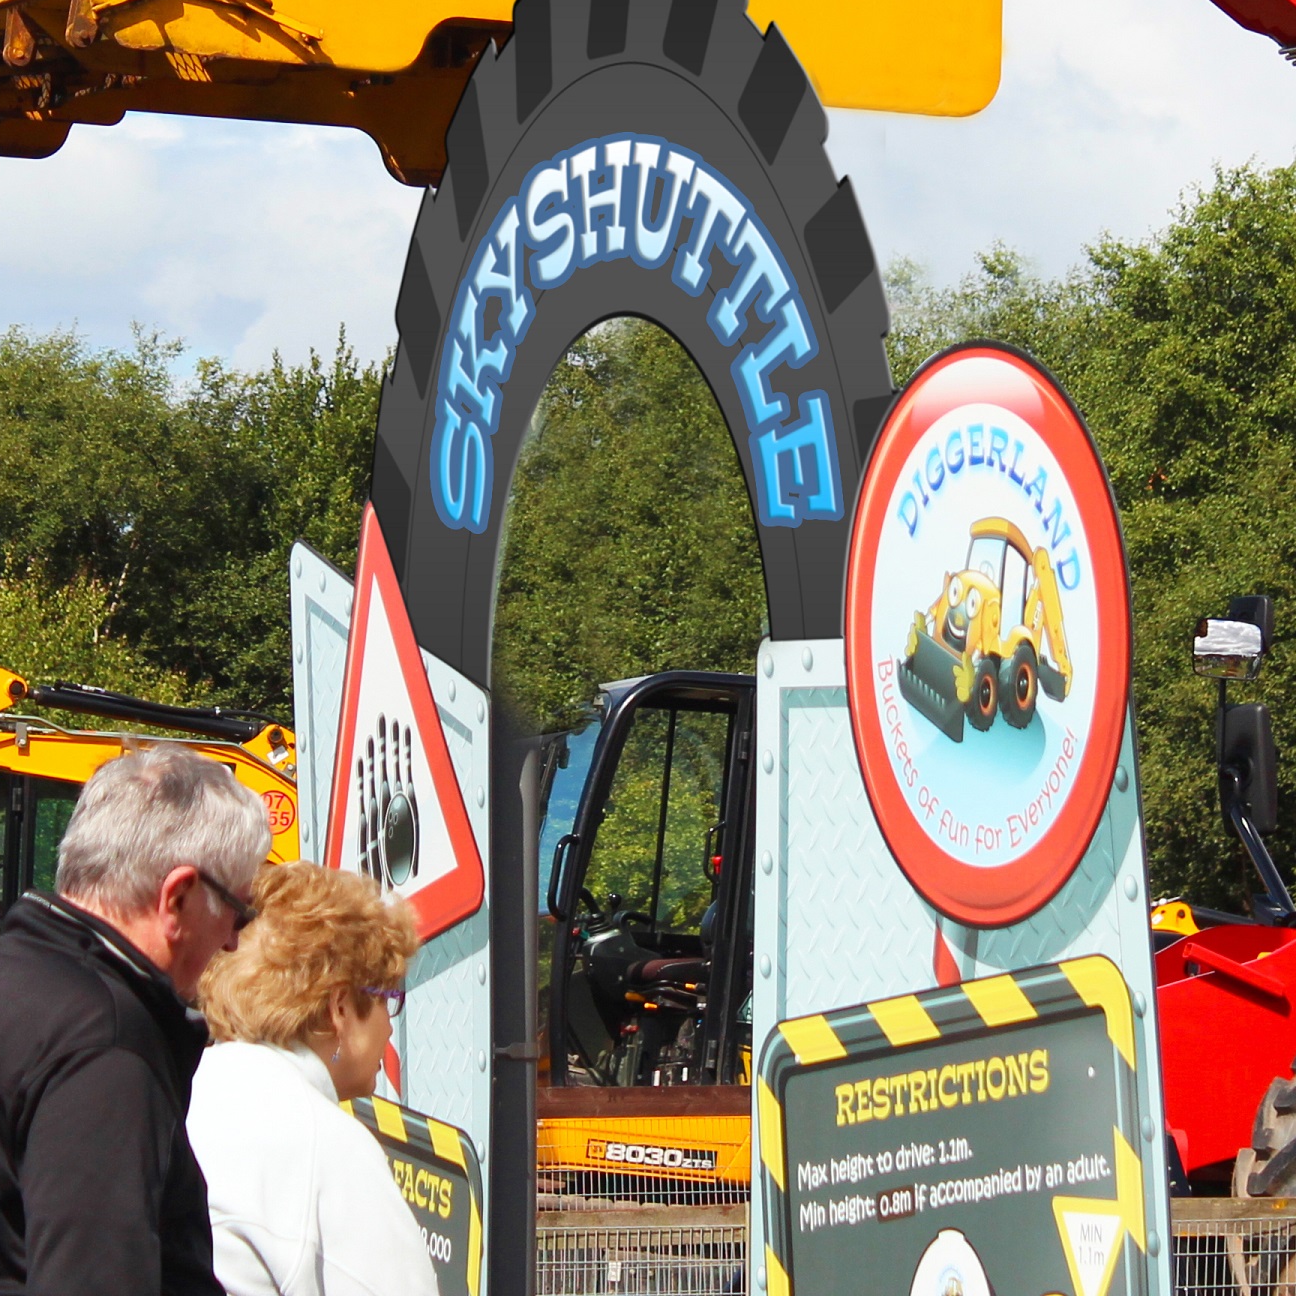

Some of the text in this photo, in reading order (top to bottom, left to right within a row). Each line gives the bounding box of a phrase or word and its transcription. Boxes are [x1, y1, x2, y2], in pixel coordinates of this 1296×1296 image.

[434, 136, 843, 530] SKYSHUTTLE
[897, 423, 1081, 591] DIGGERLAND
[877, 654, 918, 787] Buckets
[917, 786, 940, 821] of
[975, 824, 1003, 855] for
[1007, 725, 1079, 848] Everyone!
[268, 811, 291, 826] 55
[834, 1049, 1050, 1127] RESTRICTIONS
[605, 1142, 713, 1170] 8030 ZTS
[797, 1137, 973, 1192] Max height to drive: 1.1m.
[393, 1159, 452, 1219] FACTS
[799, 1153, 1111, 1233] Min height: 0.8m if accompanied by an adult.
[1079, 1245, 1105, 1267] 1.1m
[1080, 1223, 1103, 1244] MIN
